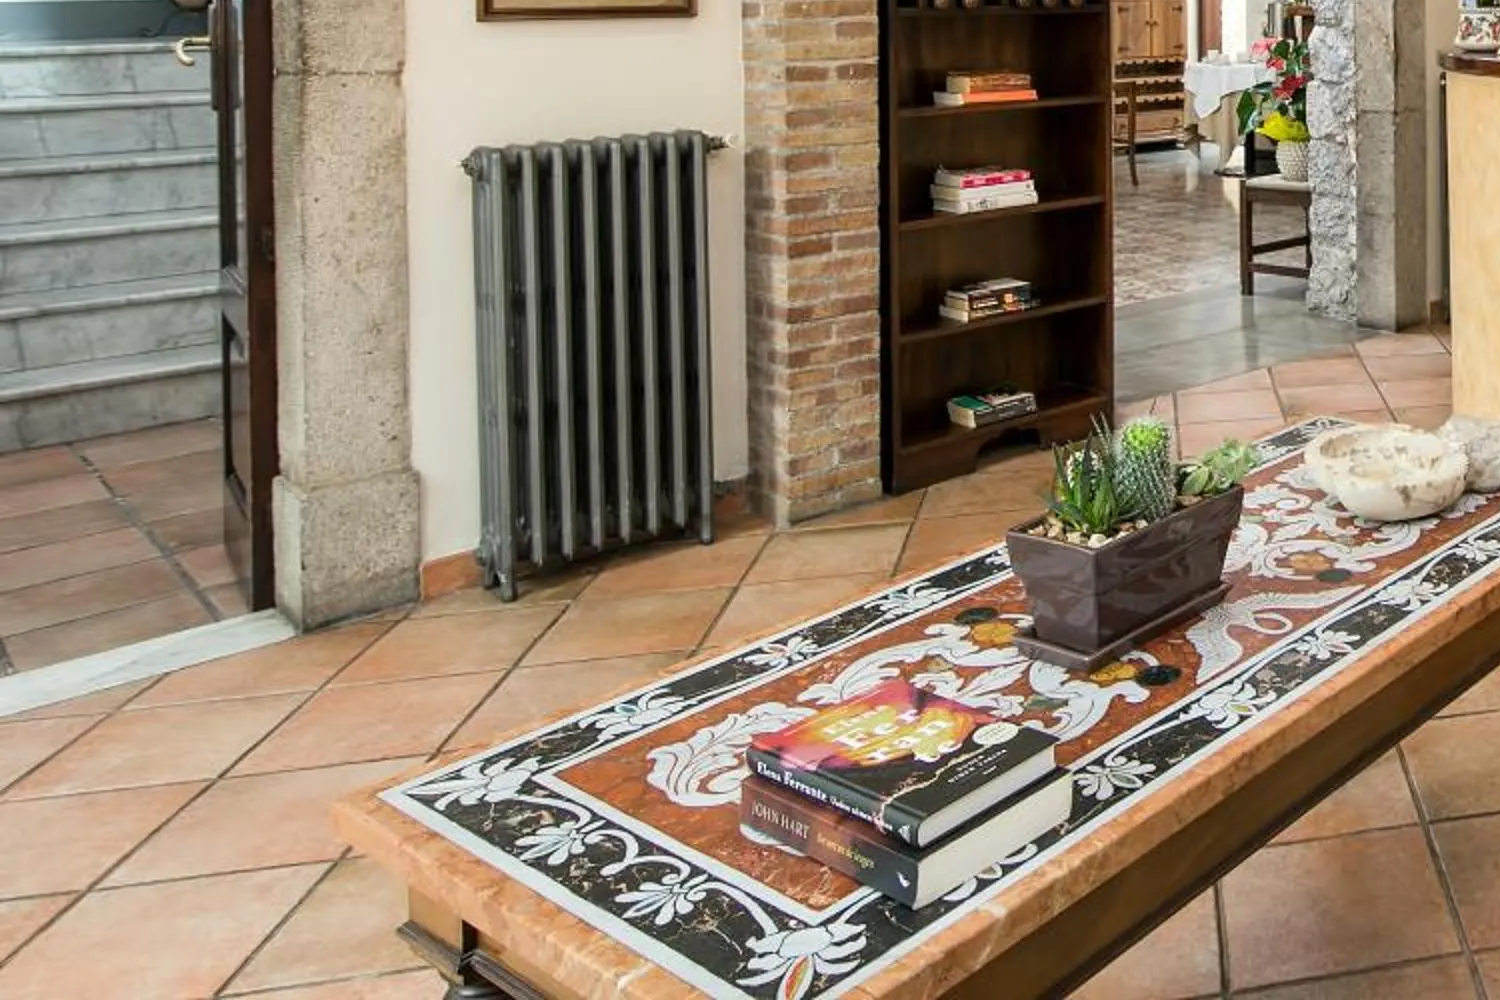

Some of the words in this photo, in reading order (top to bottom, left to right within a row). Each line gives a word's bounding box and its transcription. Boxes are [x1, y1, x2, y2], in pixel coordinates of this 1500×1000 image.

[757, 760, 782, 783] Elena
[751, 799, 780, 827] JOHN
[780, 813, 812, 840] HART
